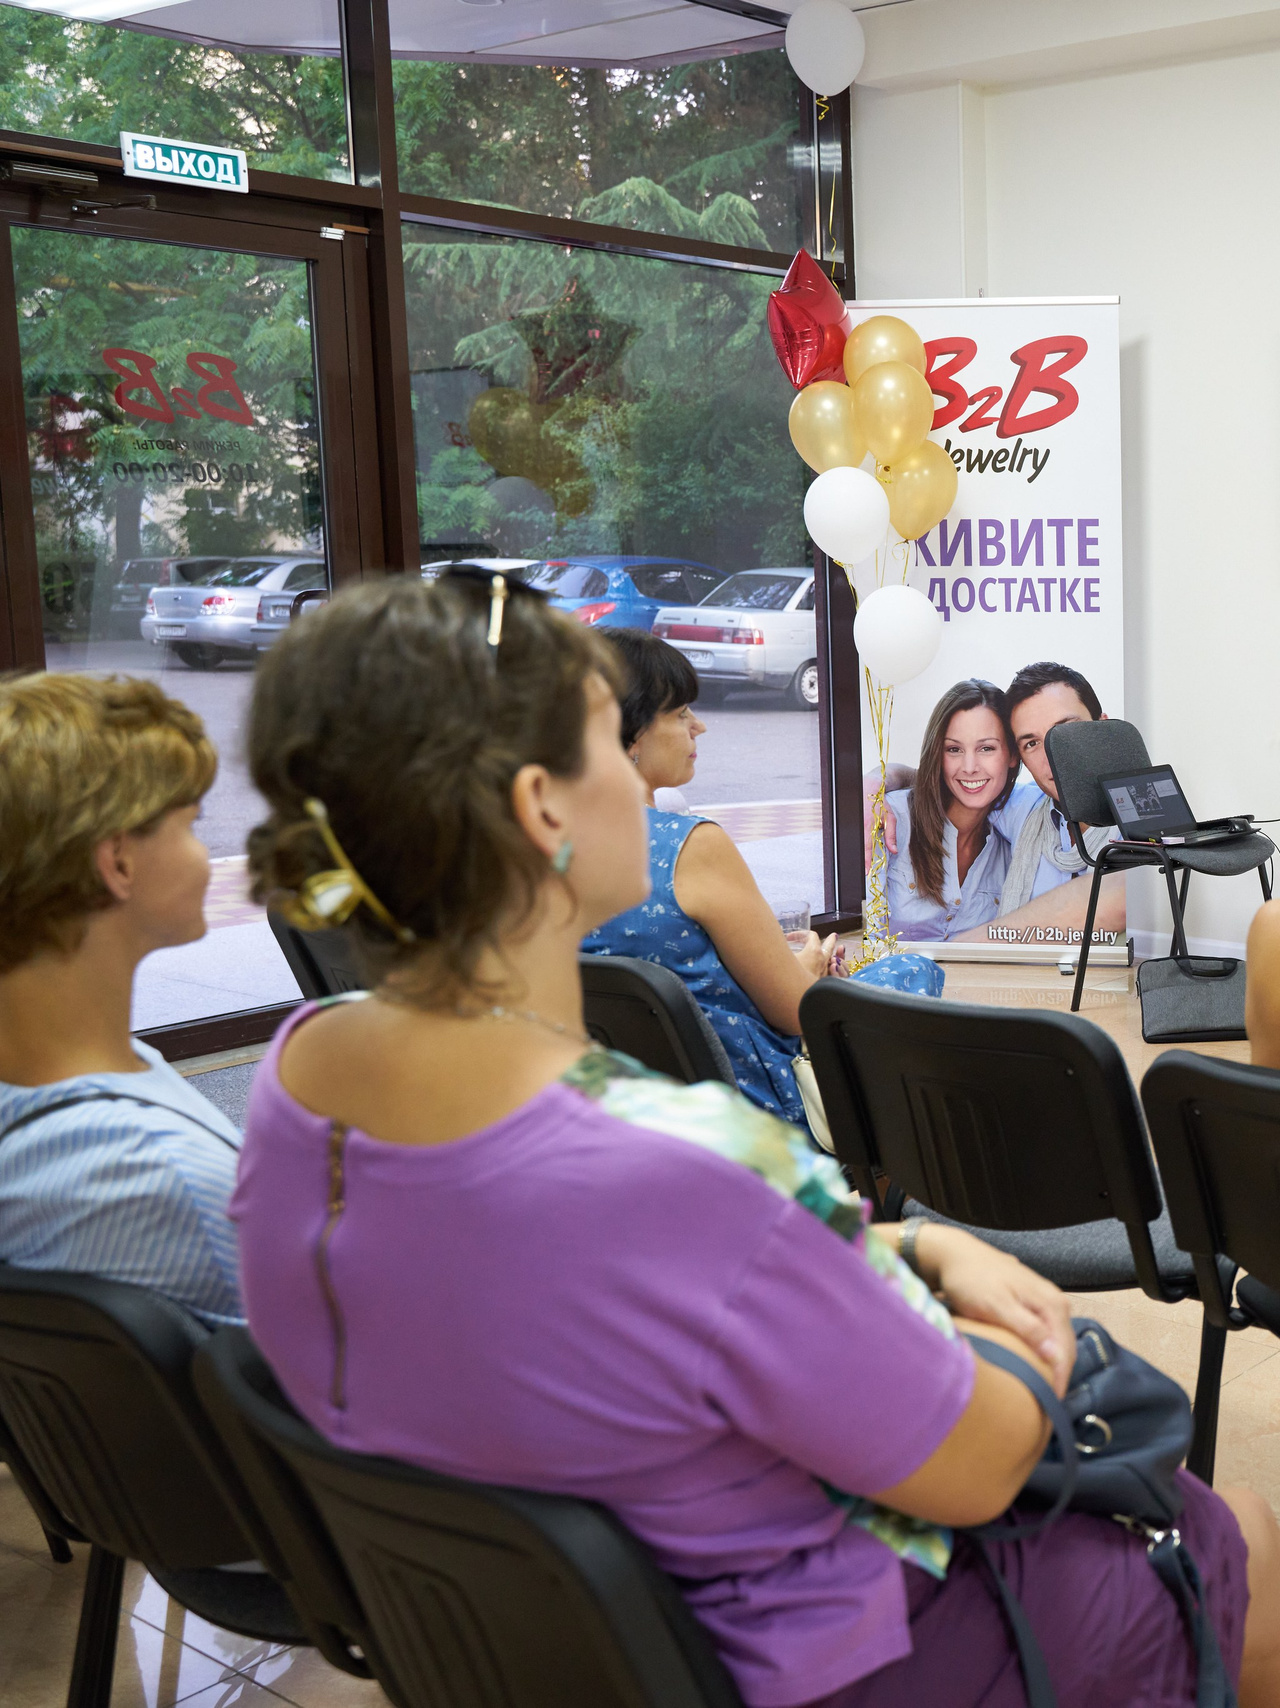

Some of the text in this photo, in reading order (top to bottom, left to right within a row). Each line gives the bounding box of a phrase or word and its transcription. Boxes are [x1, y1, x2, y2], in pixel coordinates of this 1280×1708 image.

[136, 143, 236, 185] ВЫХОД
[923, 335, 1089, 439] B2B
[928, 577, 1101, 622] ДОСТАТКЕ
